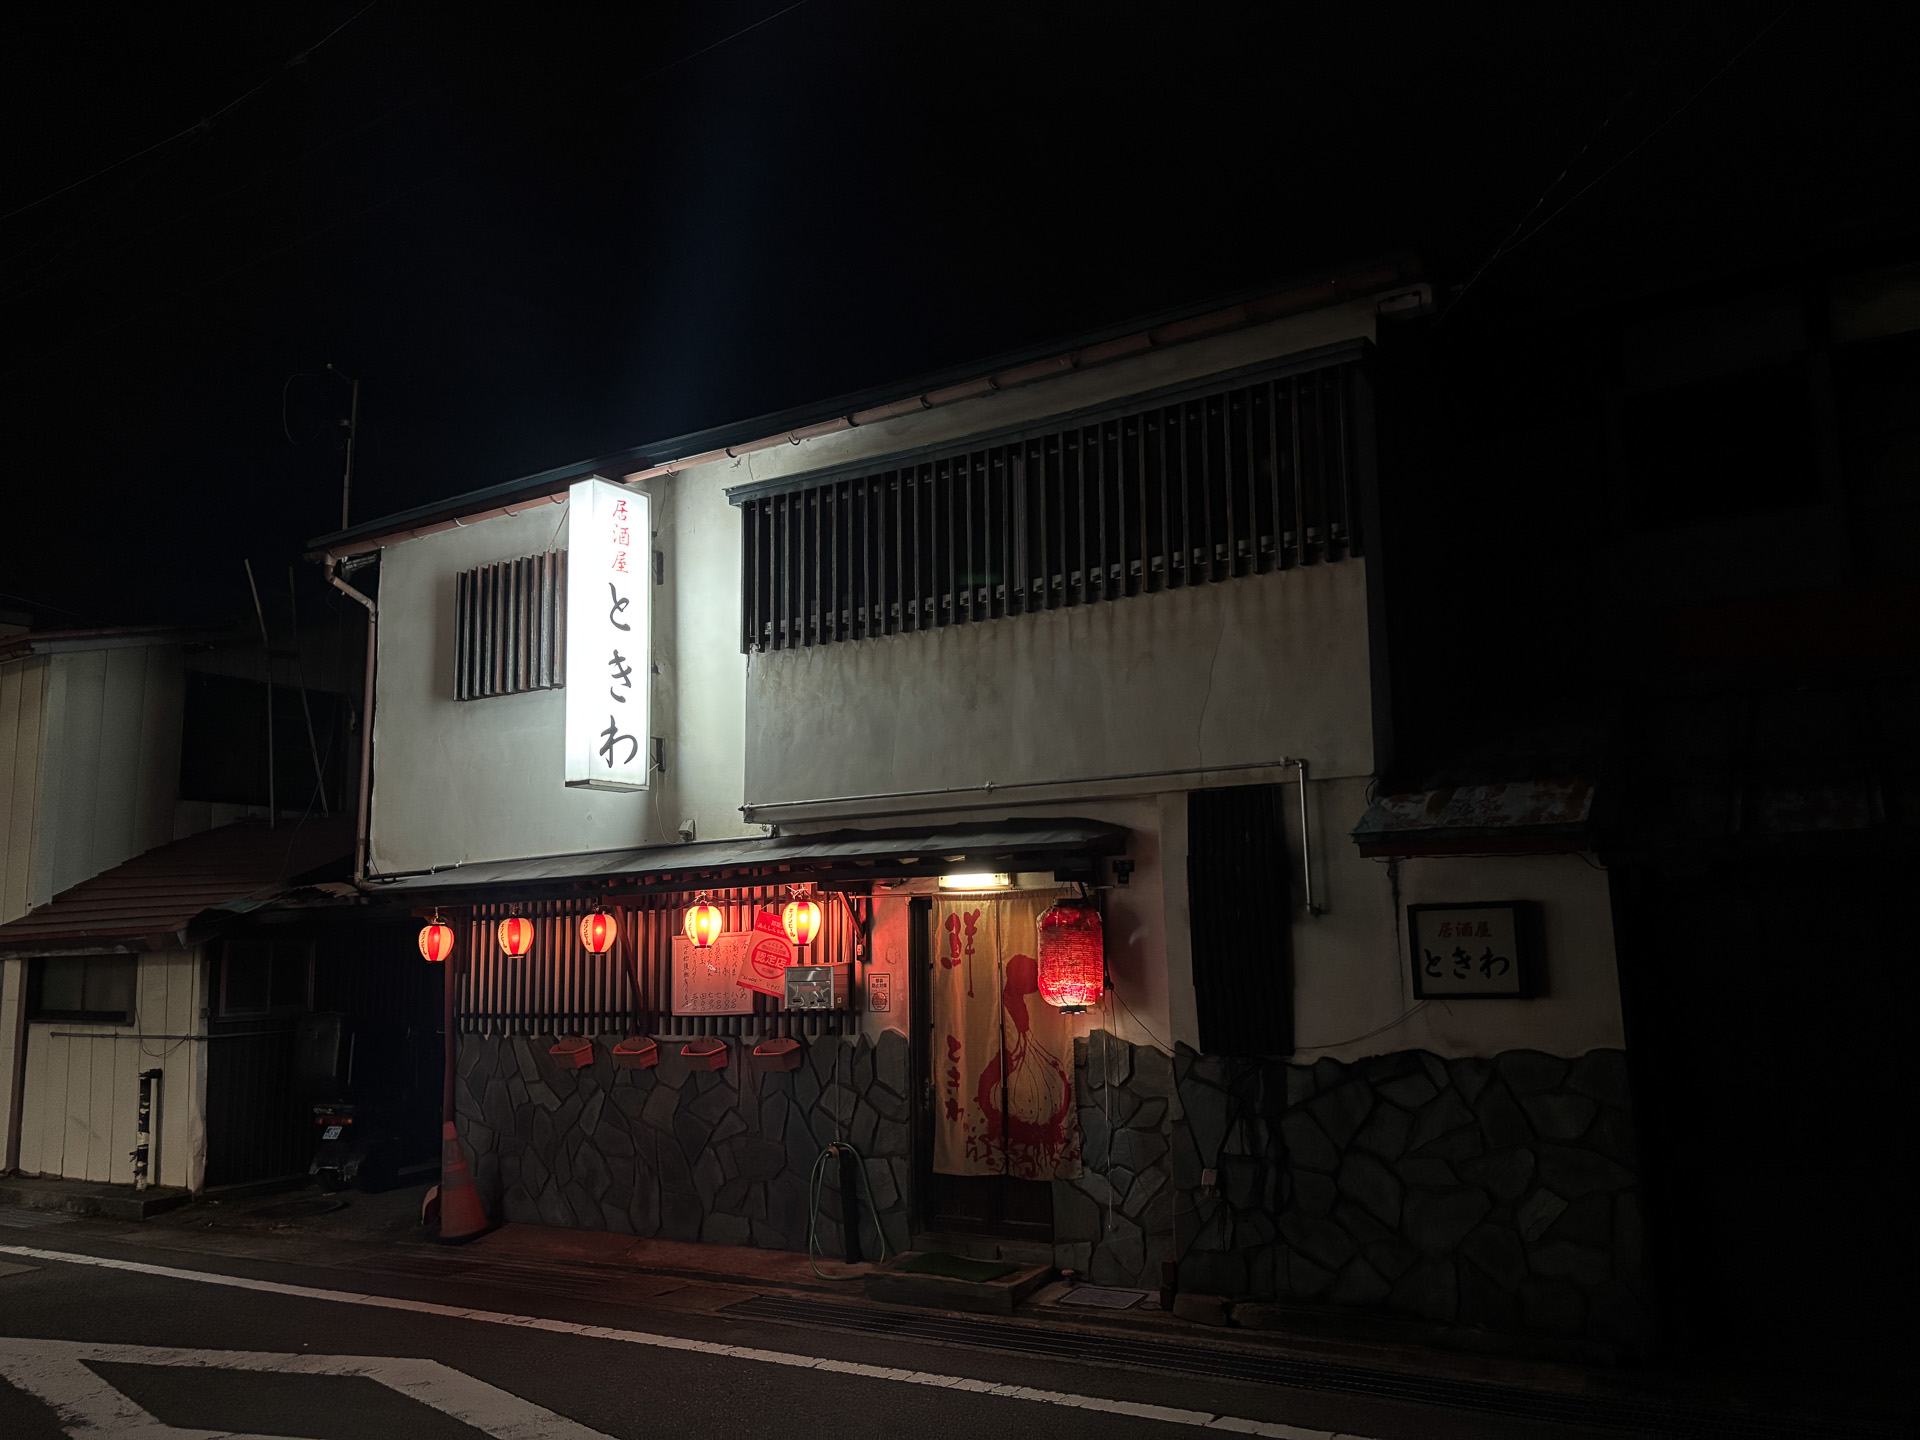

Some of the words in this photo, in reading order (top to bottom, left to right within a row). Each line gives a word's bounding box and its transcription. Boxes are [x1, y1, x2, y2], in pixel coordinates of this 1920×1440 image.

[611, 500, 630, 574] 居酒屋
[599, 582, 638, 769] ときわ
[1438, 921, 1492, 938] 居酒屋
[754, 950, 787, 969] 認定店
[1424, 946, 1510, 979] ときわ
[945, 1034, 965, 1122] ときわ
